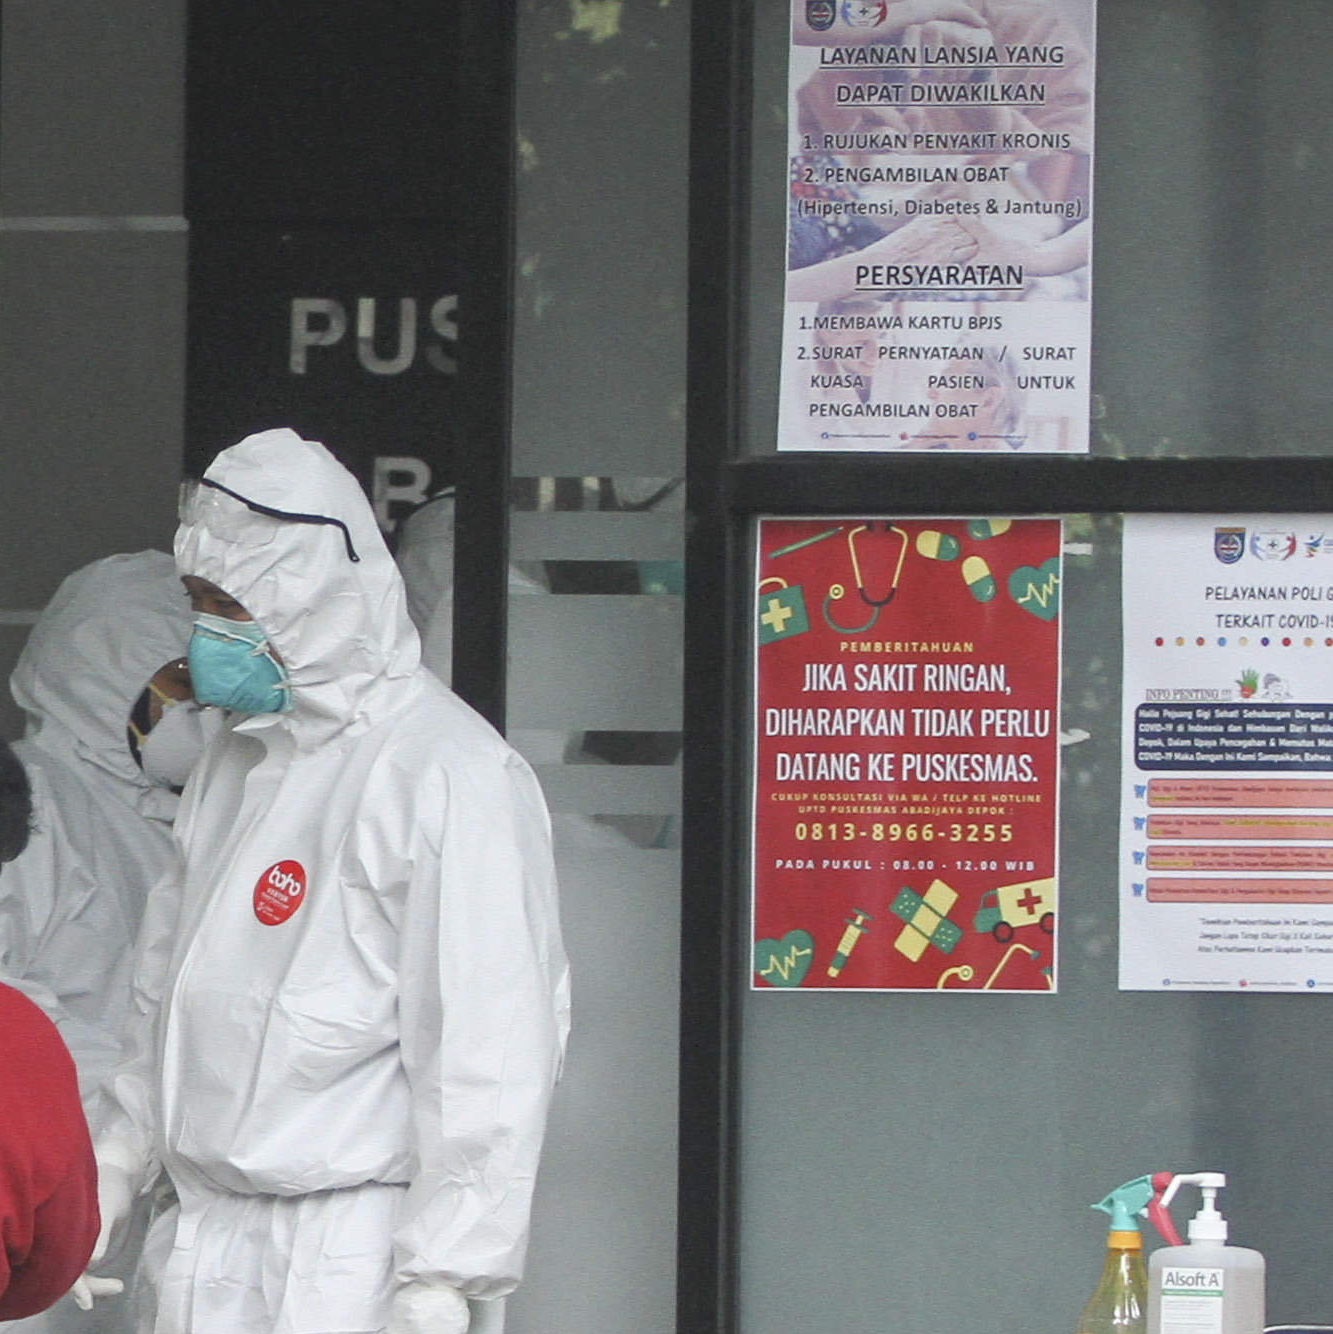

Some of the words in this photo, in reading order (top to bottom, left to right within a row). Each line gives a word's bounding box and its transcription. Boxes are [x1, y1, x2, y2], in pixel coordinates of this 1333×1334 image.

[820, 46, 916, 65] LAYANAN
[924, 46, 998, 64] LANSIA
[1006, 46, 1064, 64] YANG
[837, 85, 904, 103] DAPAT
[911, 84, 1045, 102] DIWAKILKAN
[804, 135, 817, 149] 1.
[824, 134, 907, 149] RUJUKAN
[914, 133, 996, 149] PENYAKIT
[1003, 133, 1071, 148] KRONIS
[804, 168, 819, 183] 2.
[826, 168, 958, 182] PENGAMBILAN
[964, 167, 1009, 182] OBAT
[797, 200, 898, 218] (Hipertensi,
[905, 200, 980, 215] Diabetes
[986, 200, 999, 215] &
[1004, 199, 1082, 218] Jantung)
[856, 265, 1023, 286] PERSYARATAN
[908, 316, 963, 330] KARTU
[968, 316, 1002, 331] BPJS
[879, 347, 983, 360] PERNYATAAN
[1023, 347, 1076, 360] SURAT
[811, 375, 864, 389] KUASA
[928, 375, 983, 389] PASIEN
[1017, 375, 1075, 389] UNTUK
[809, 403, 930, 418] PENGAMBILAN
[935, 403, 978, 418] OBAT
[1205, 586, 1287, 600] PELAYANAN
[1291, 587, 1323, 600] POLI
[1215, 614, 1275, 628] TERKAIT
[840, 642, 974, 653] PEMBERITAHUAN
[802, 664, 847, 691] JIKA
[854, 664, 917, 691] SAKIT
[924, 664, 1011, 695] RINGAN,
[1146, 689, 1170, 699] INFO
[1173, 689, 1218, 699] PENTING
[766, 708, 904, 736] DIHARAPKAN
[911, 709, 974, 737] TIDAK
[981, 709, 1050, 737] PERLU
[776, 753, 861, 782] DATANG
[868, 753, 895, 782] KE
[902, 753, 1038, 782] PUSKESMAS.
[771, 793, 809, 801] CUKUP
[813, 793, 882, 801] KONSULTASI
[912, 794, 928, 802] WA
[942, 794, 968, 802] TELP
[973, 794, 985, 802] KE
[992, 794, 1041, 802] HOTLINE
[798, 806, 826, 814] UPTD
[831, 806, 897, 814] PUSKESMAS
[901, 806, 963, 815] ABADIJAYA
[968, 806, 1005, 815] DEPOK
[795, 823, 1013, 842] 0813-8966-3255
[775, 859, 814, 869] PADA
[822, 860, 872, 870] PUKUL
[893, 860, 934, 870] 08.00
[956, 860, 997, 870] 12.00
[1005, 861, 1035, 871] WIB
[1165, 1272, 1206, 1287] Alsoft
[1208, 1273, 1219, 1287] A
